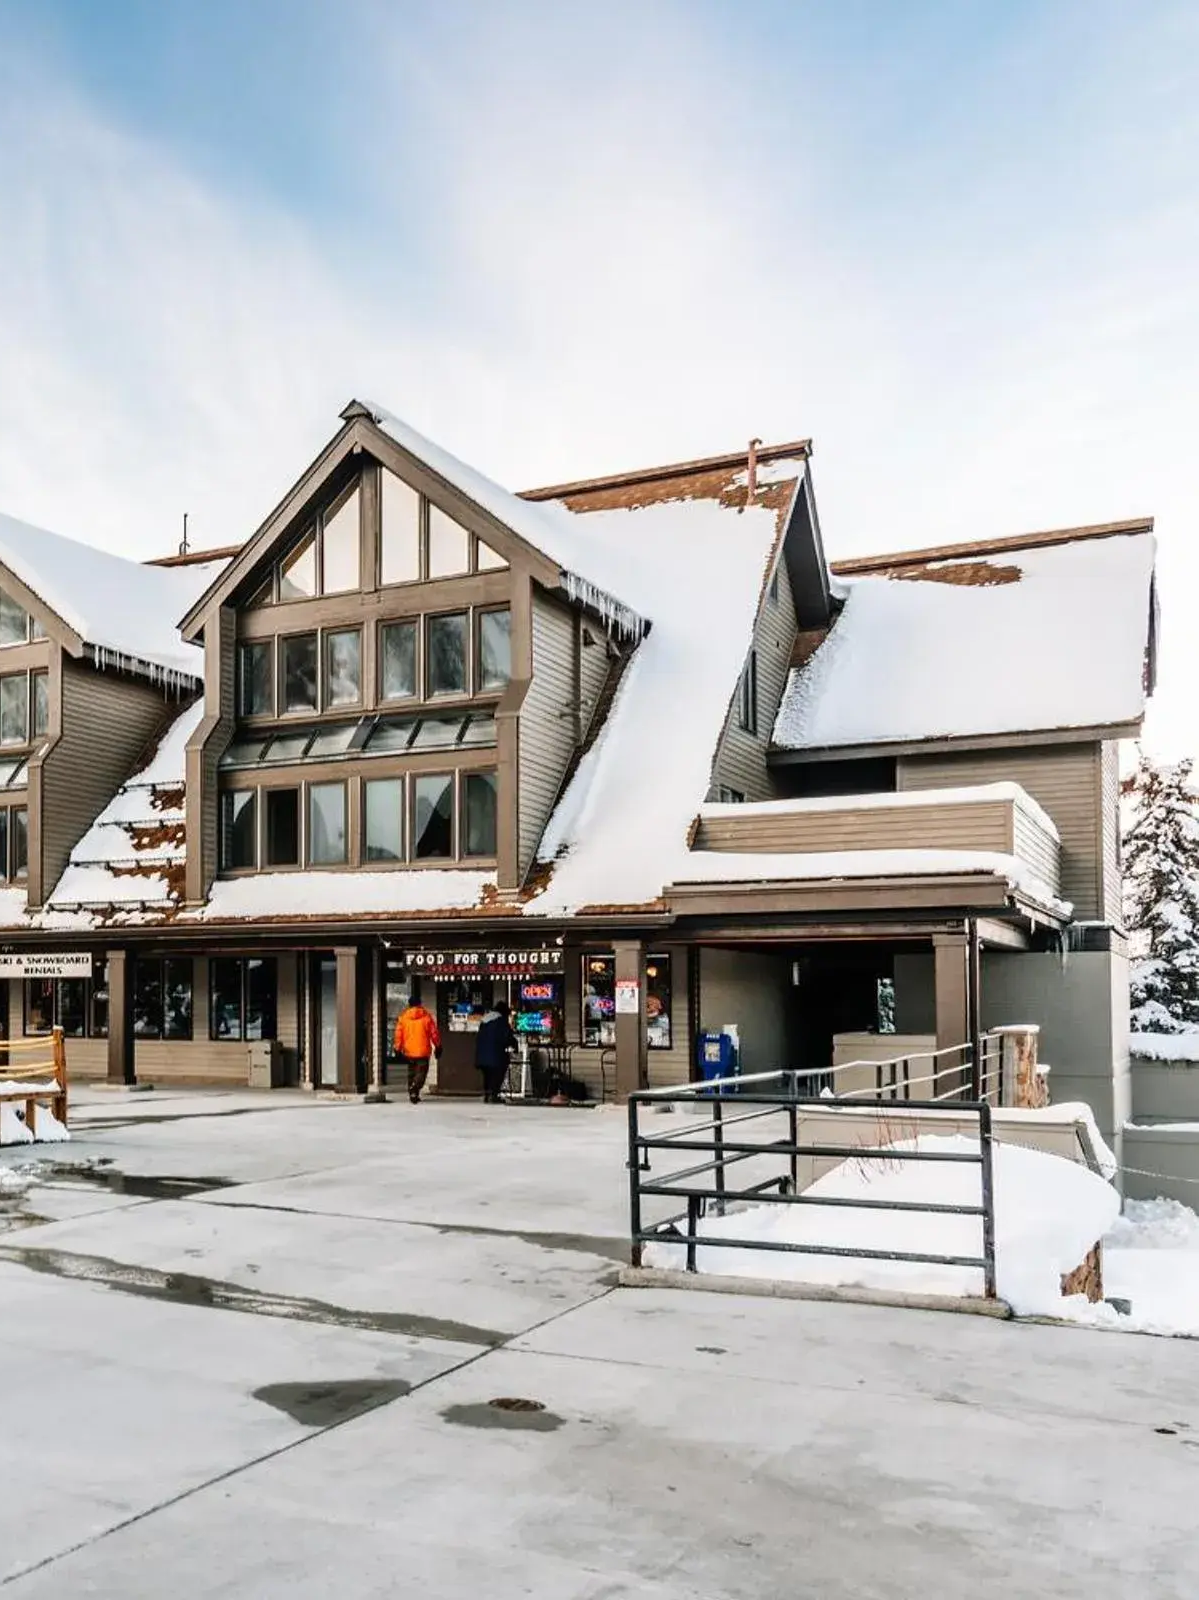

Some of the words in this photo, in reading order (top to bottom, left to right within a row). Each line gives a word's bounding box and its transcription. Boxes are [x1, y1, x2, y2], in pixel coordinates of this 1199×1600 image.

[16, 957, 23, 965] &
[27, 956, 90, 965] SNOWBOARD
[406, 953, 445, 965] FOOD
[453, 953, 479, 965] FOR
[486, 952, 561, 964] THOUGHT
[24, 966, 62, 975] RENTALS
[524, 985, 552, 998] OPEN
